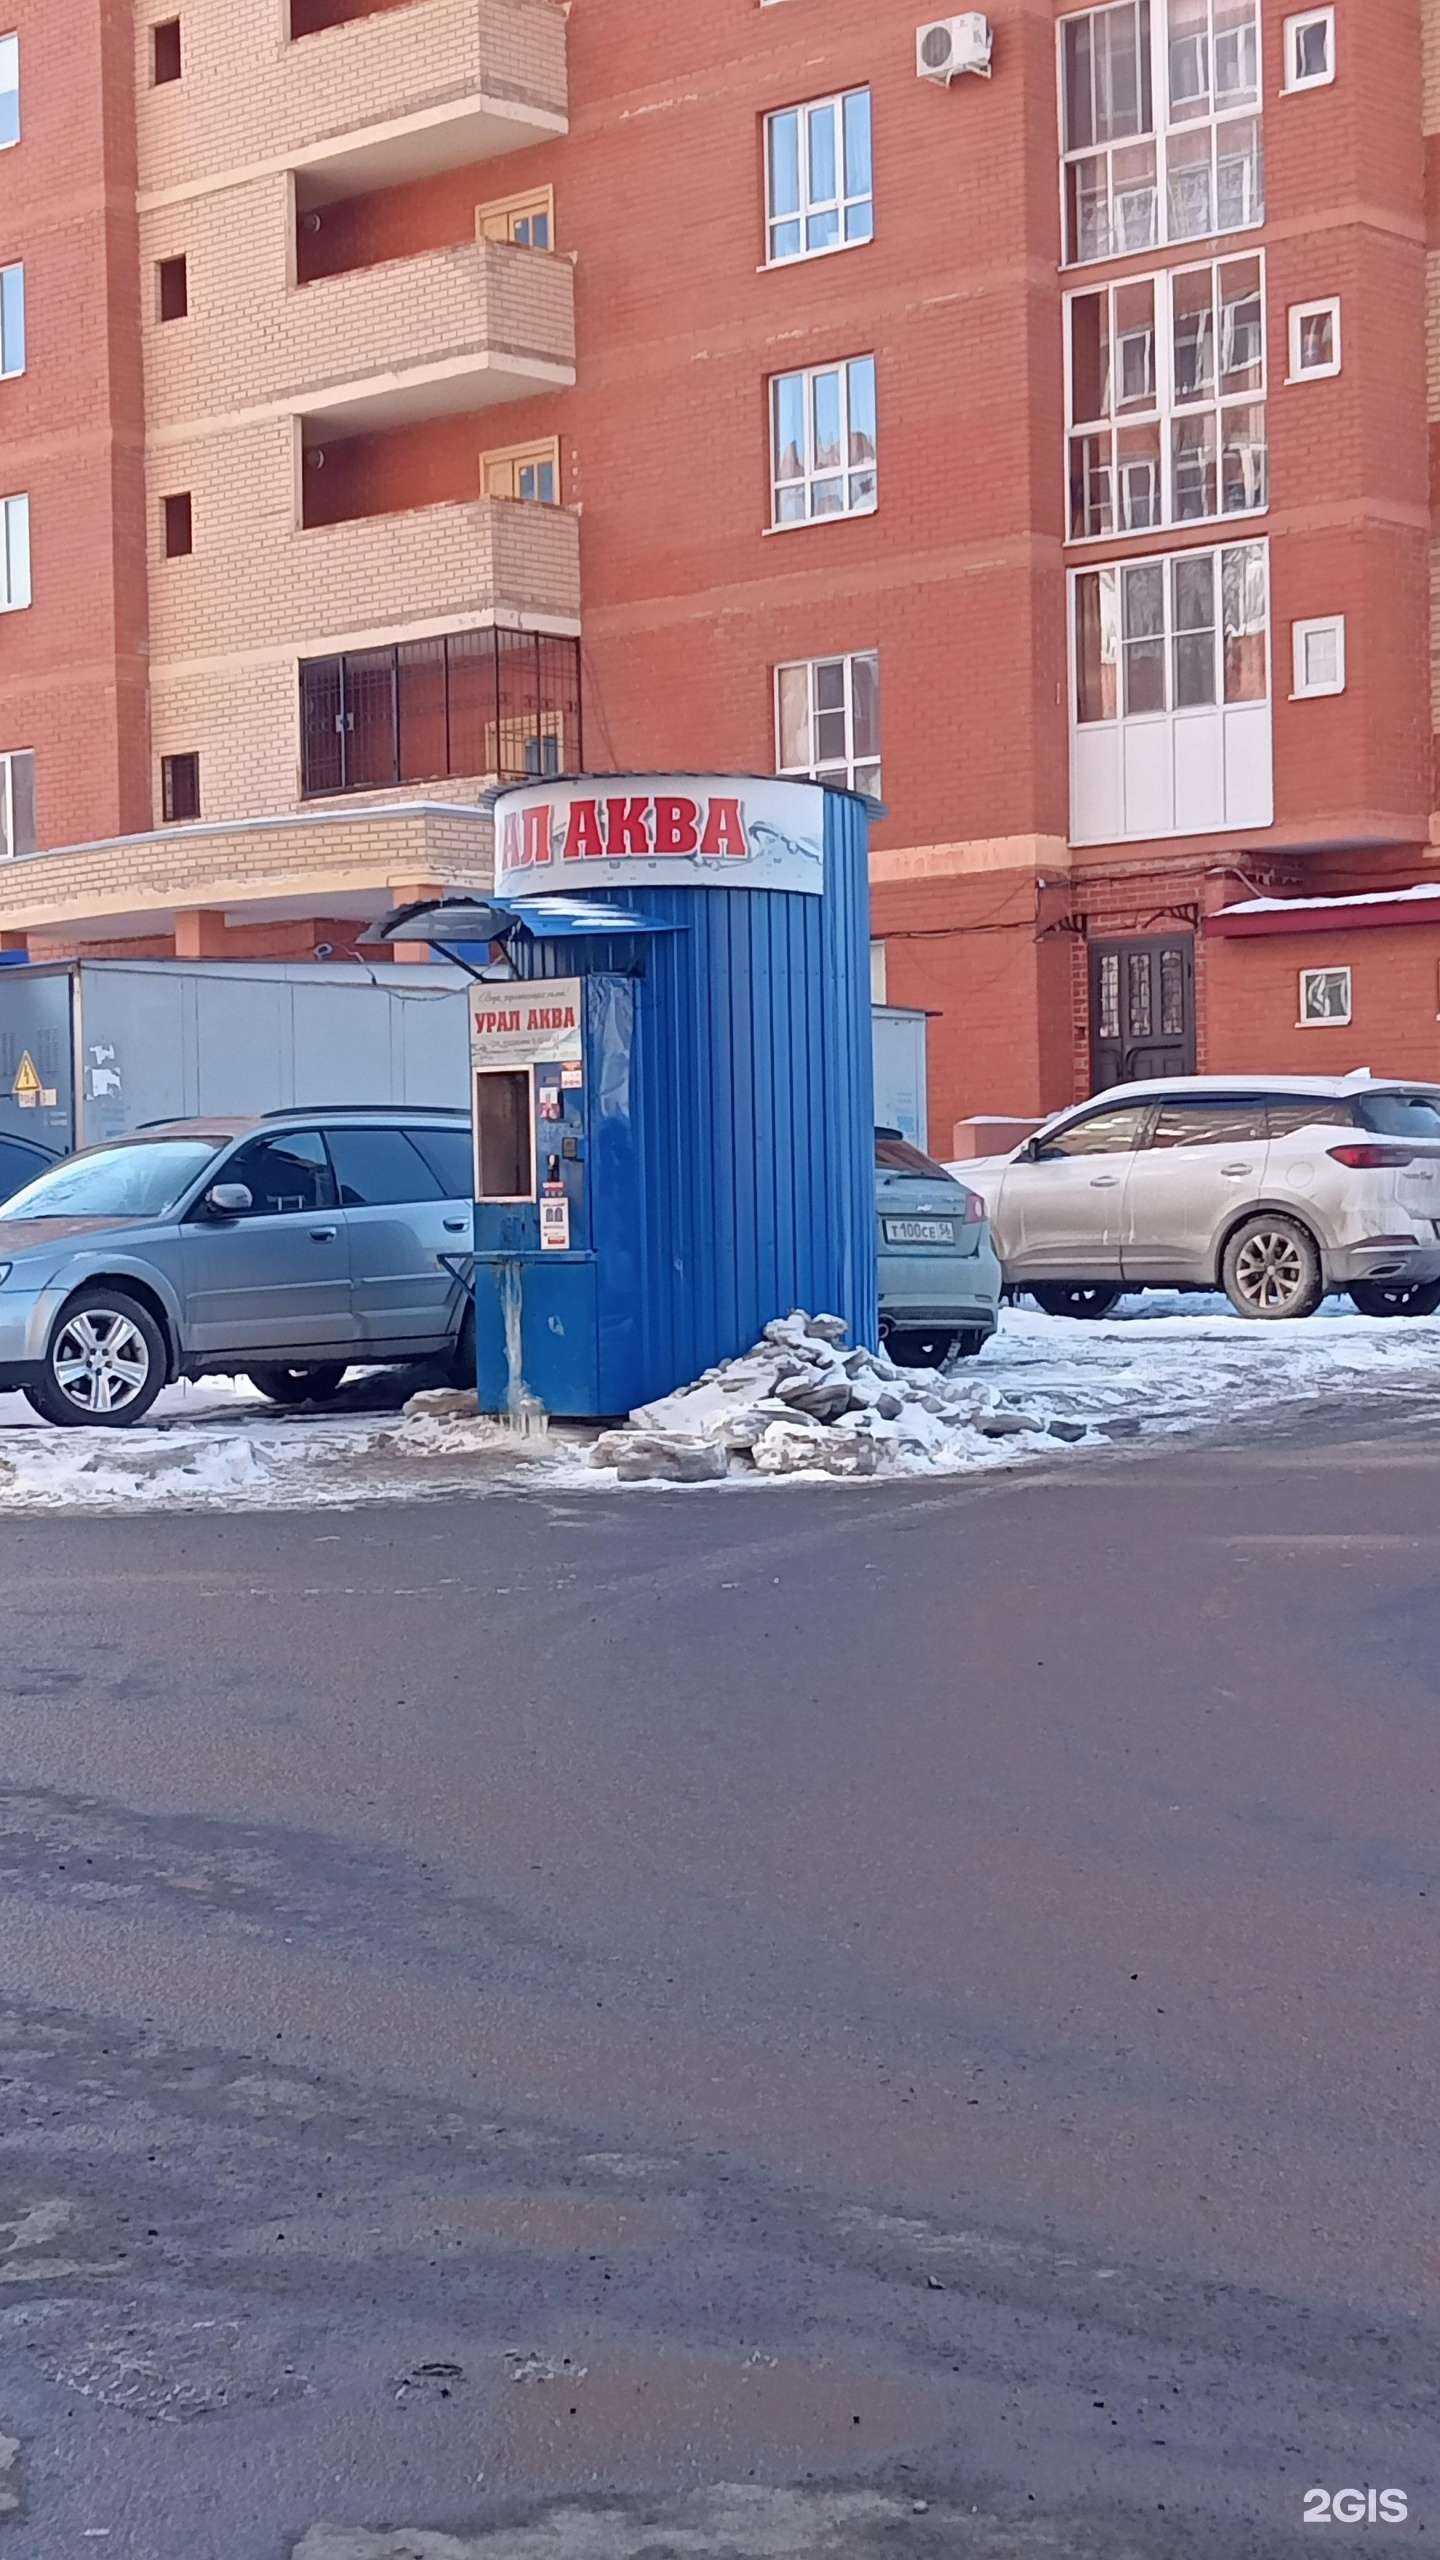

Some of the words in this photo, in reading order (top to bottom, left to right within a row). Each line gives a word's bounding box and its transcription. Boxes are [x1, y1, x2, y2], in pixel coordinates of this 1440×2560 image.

[563, 797, 746, 858] АКВА
[474, 1010, 521, 1034] УРАЛ
[527, 1006, 576, 1031] АКВА
